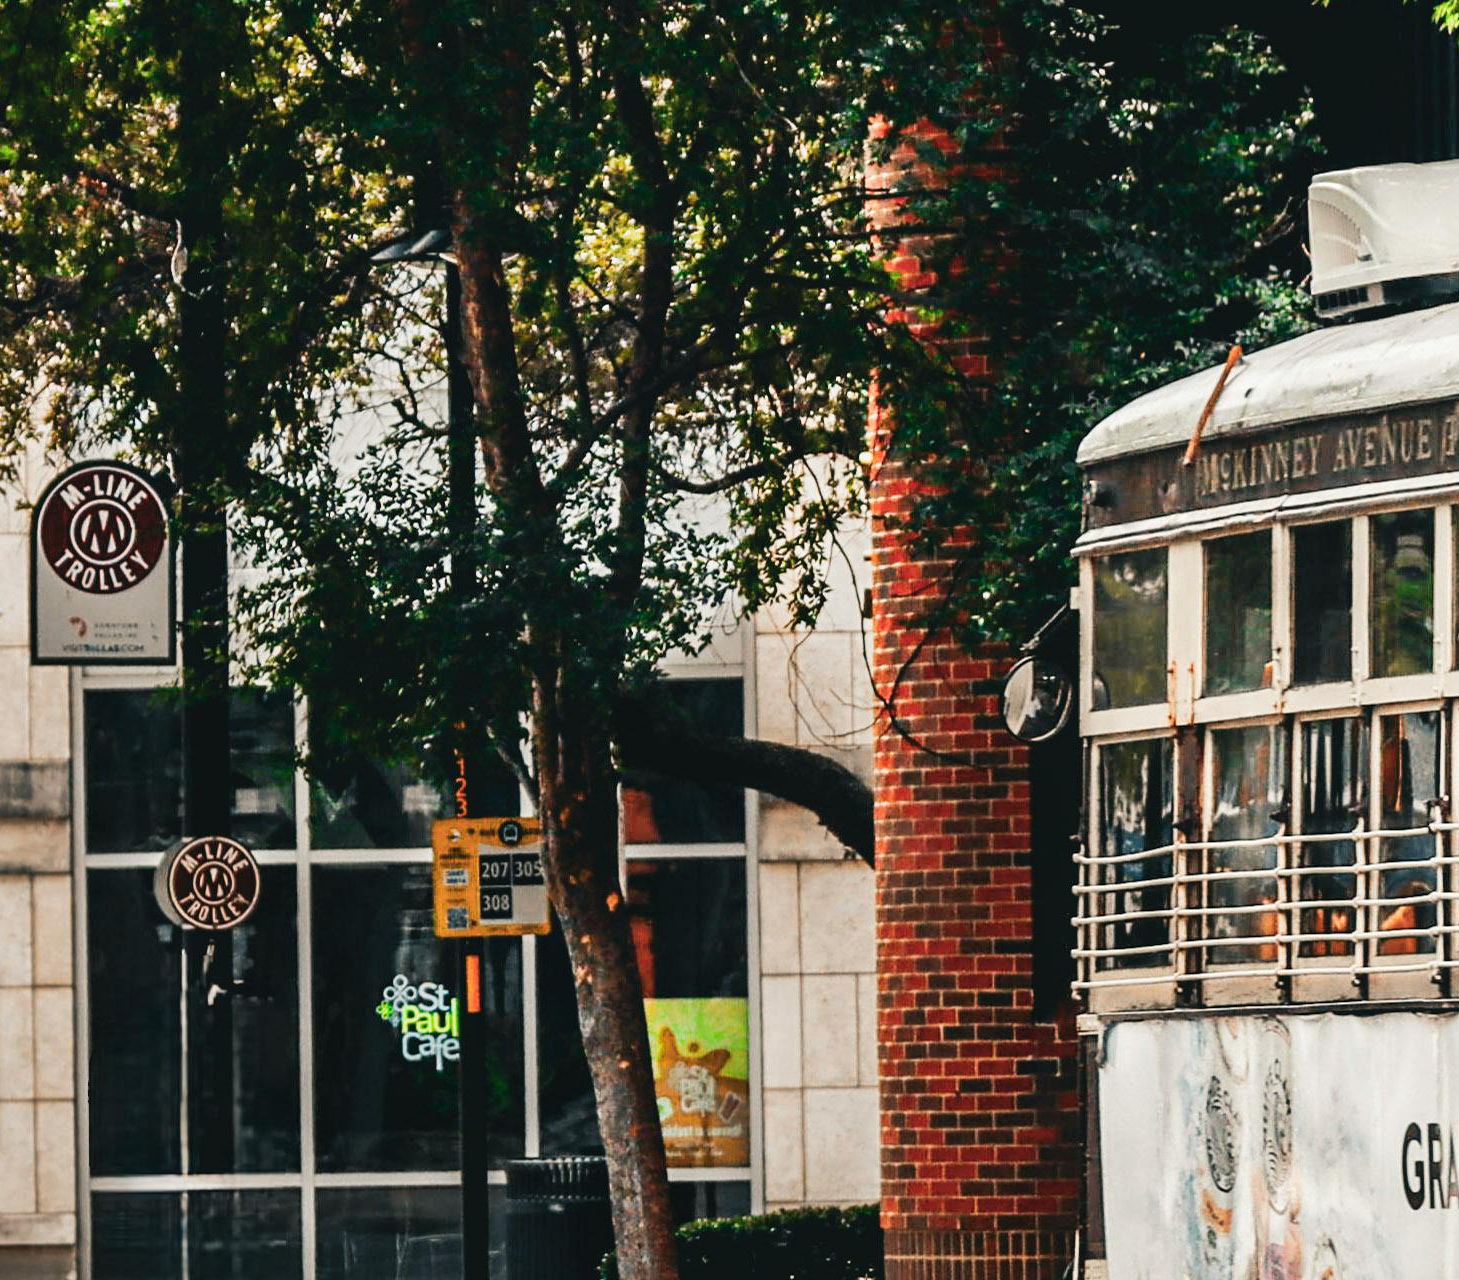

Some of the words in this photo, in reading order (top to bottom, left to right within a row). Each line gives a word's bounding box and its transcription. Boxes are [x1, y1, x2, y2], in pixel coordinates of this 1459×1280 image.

[1333, 418, 1433, 472] AVENUE
[59, 474, 148, 510] M-LINE
[54, 548, 149, 590] TROLLEY
[180, 842, 249, 873] M-LINE
[481, 862, 508, 878] 207
[515, 861, 543, 877] 305
[179, 892, 249, 923] TROLLEY
[482, 894, 510, 911] 308
[418, 982, 450, 1011] St
[401, 998, 459, 1037] Paul
